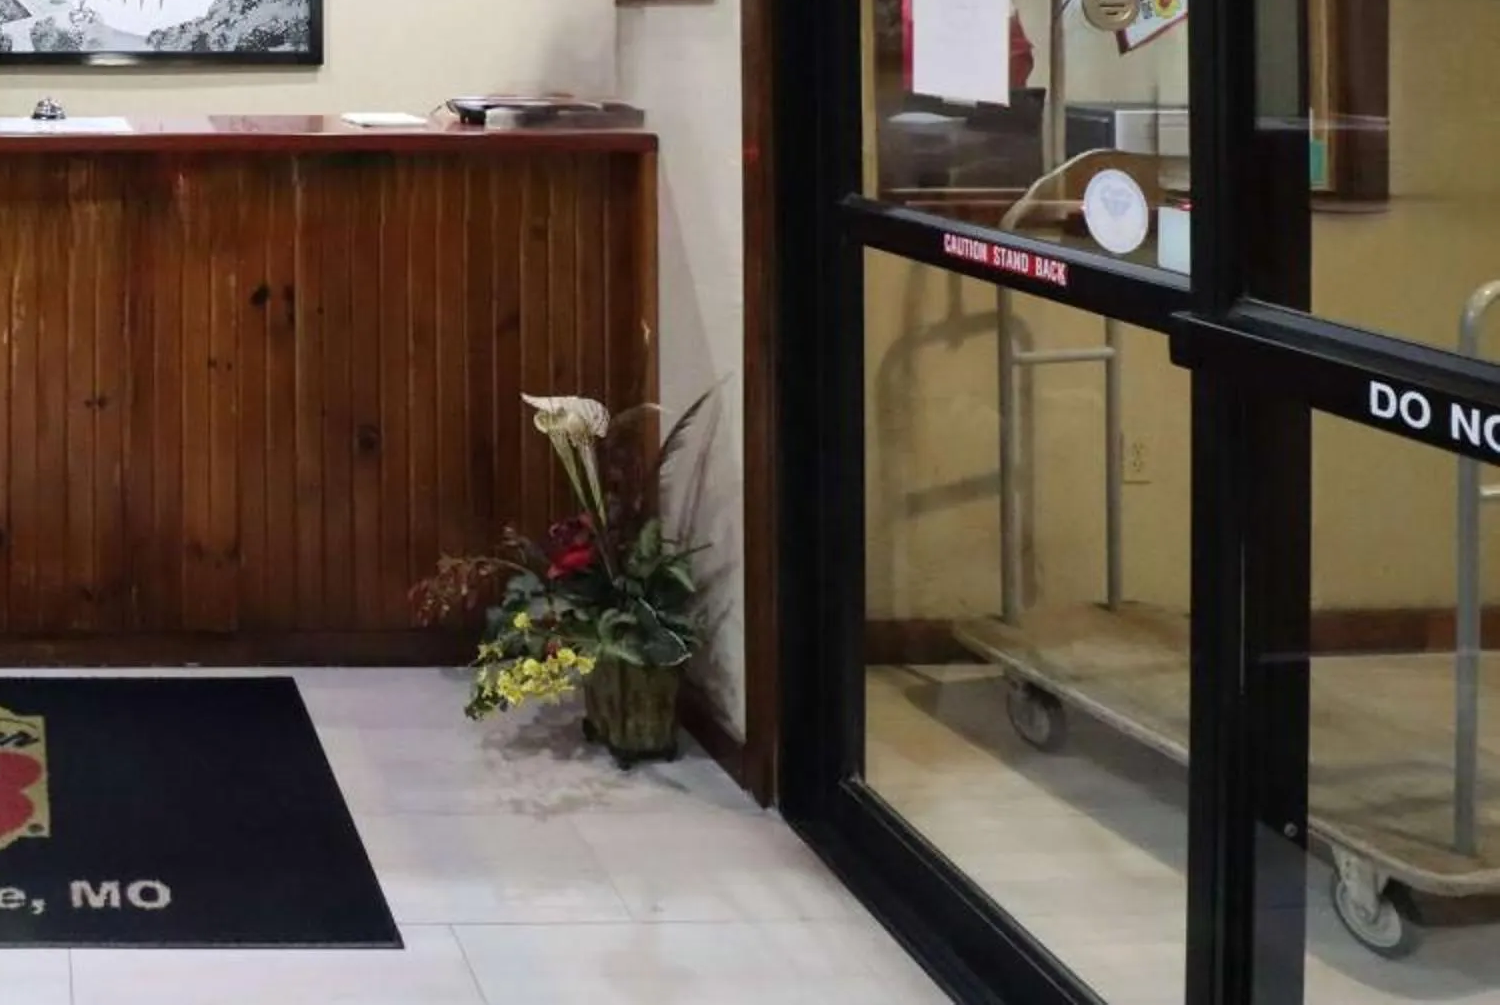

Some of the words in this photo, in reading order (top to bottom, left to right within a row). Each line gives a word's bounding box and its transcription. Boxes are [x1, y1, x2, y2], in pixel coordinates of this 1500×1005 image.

[943, 233, 988, 263] CAUTION
[992, 245, 1029, 274] STAND
[1035, 256, 1067, 287] BACK
[1369, 380, 1431, 430] DO
[69, 880, 171, 910] MO
